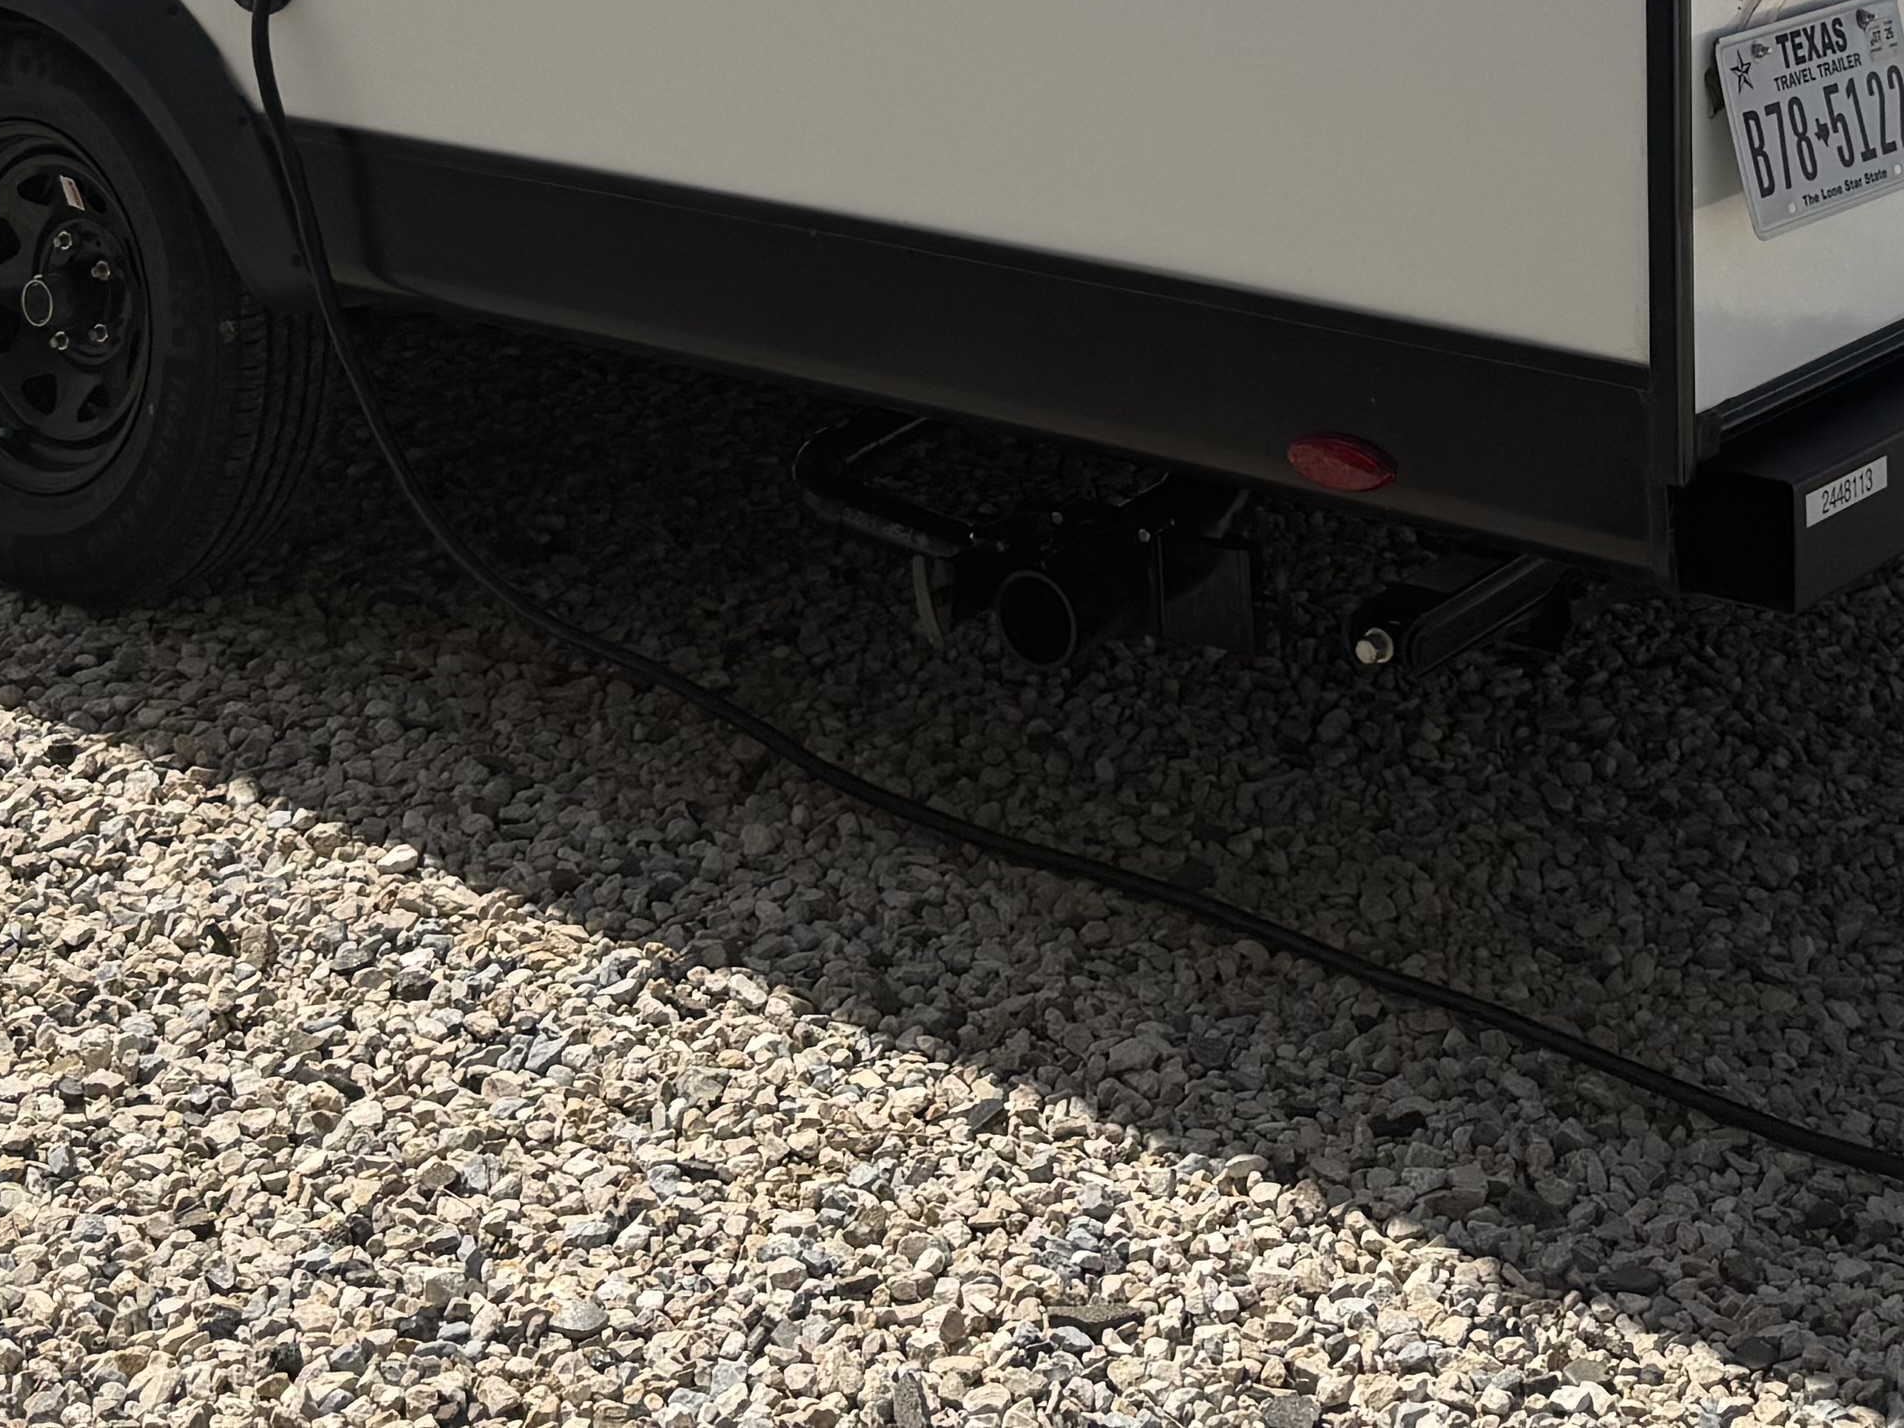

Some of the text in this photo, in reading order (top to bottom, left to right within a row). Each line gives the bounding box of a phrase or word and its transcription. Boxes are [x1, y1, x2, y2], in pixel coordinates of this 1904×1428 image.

[1775, 17, 1847, 69] TEXAS
[1774, 52, 1862, 91] TRAVEL TRAILER
[1802, 169, 1887, 206] The Lone Star State
[1822, 467, 1873, 515] 2448113
